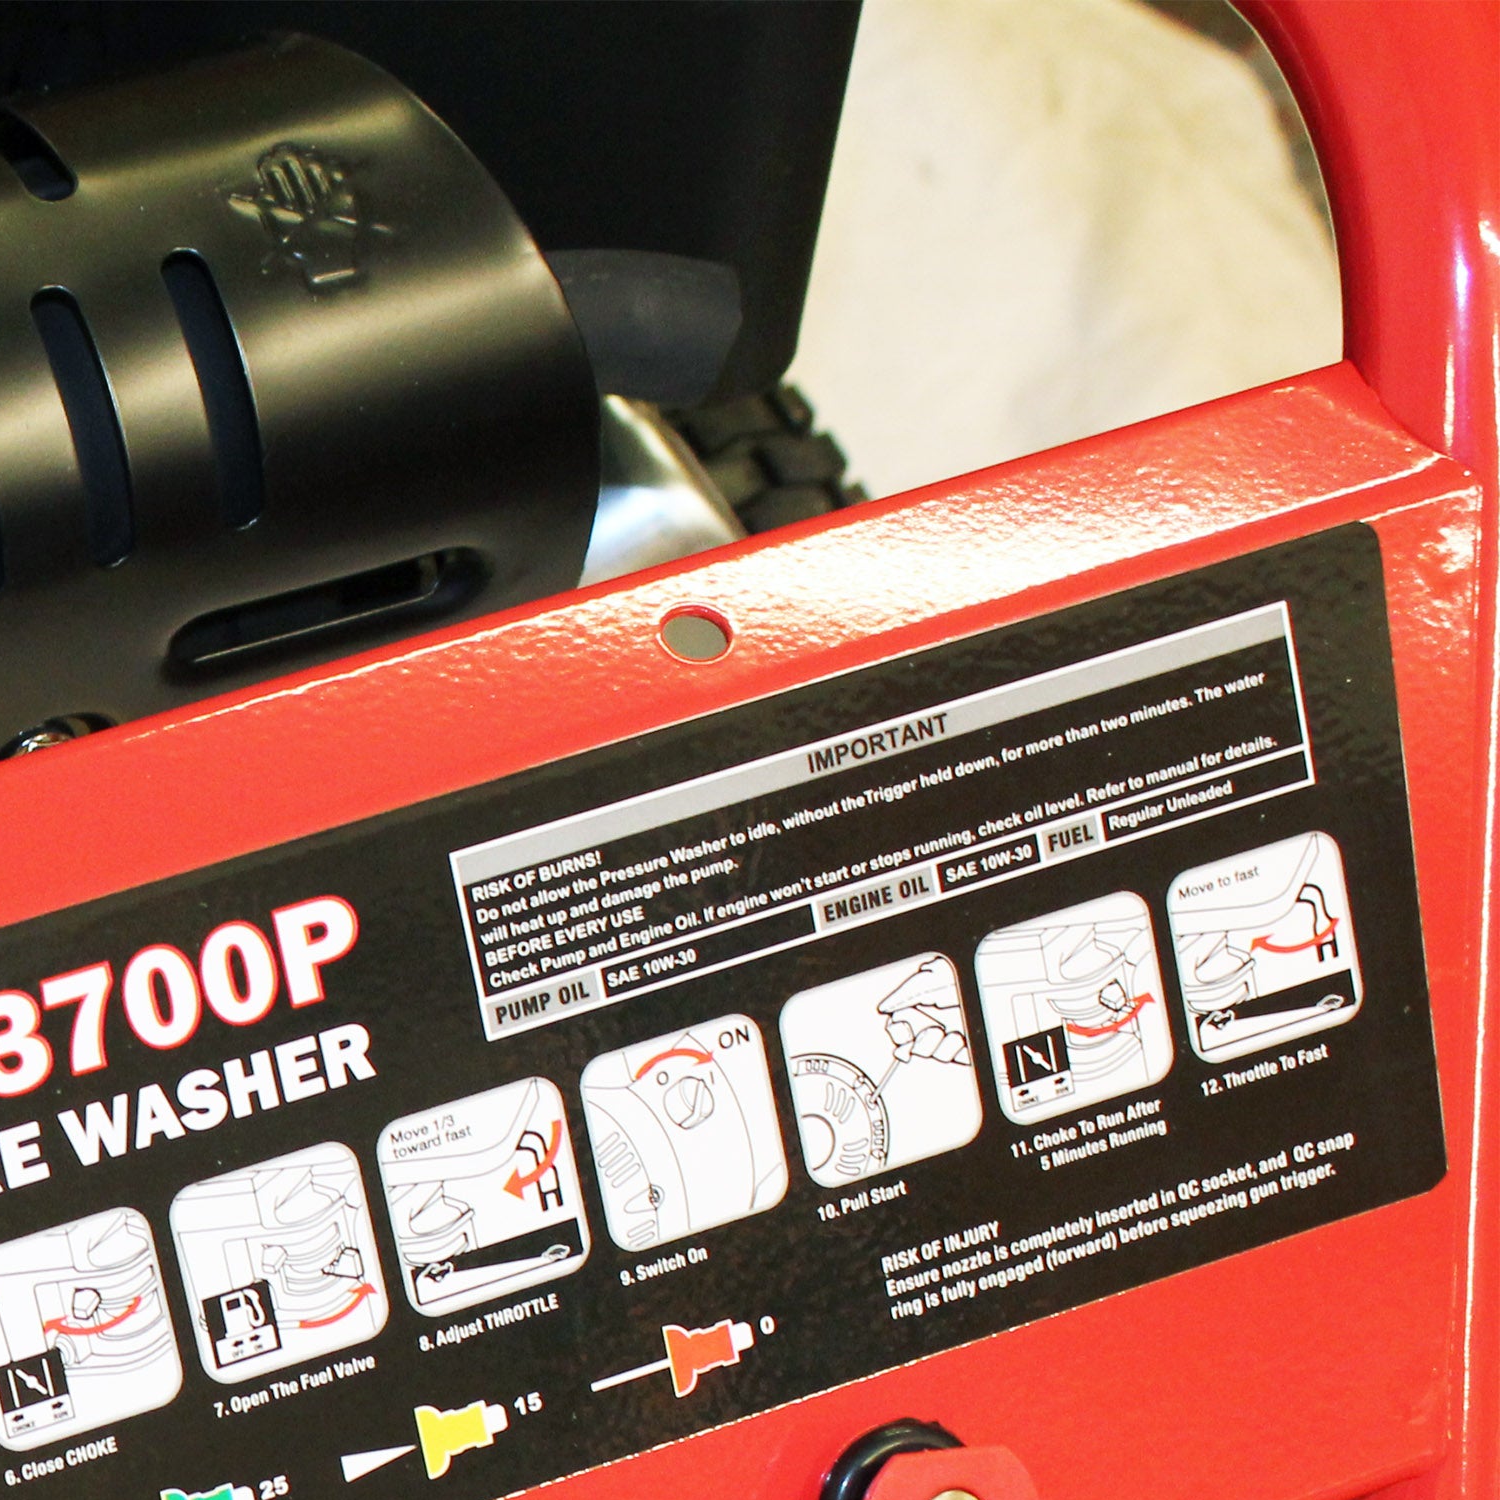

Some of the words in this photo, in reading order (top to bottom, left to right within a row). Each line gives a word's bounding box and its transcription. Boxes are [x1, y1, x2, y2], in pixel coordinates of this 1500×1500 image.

[806, 711, 948, 774] IMPORTANT
[475, 907, 499, 924] Do
[500, 896, 528, 917] not
[529, 884, 571, 908] allow
[571, 877, 598, 895] the
[598, 855, 669, 887] Pressure
[668, 836, 728, 865] Washer
[728, 832, 746, 847] to
[746, 821, 782, 841] idle,
[781, 801, 840, 830] without
[918, 765, 953, 788] held
[954, 755, 1000, 778] down,
[1000, 746, 1023, 763] for
[1024, 734, 1063, 756] more
[1064, 723, 1099, 744] than
[1099, 714, 1128, 733] two
[1129, 696, 1193, 724] minutes.
[1193, 685, 1223, 703] The
[1223, 672, 1265, 695] water
[1107, 803, 1163, 831] Regular
[1165, 779, 1233, 813] Unleaded
[1046, 823, 1094, 853] FUEL
[471, 876, 512, 903] RISK
[512, 869, 536, 889] OF
[537, 849, 602, 882] BURNS!
[945, 860, 978, 883] SAE
[980, 843, 1032, 872] 10W-30
[1177, 881, 1214, 900] Move
[1216, 876, 1231, 888] to
[1233, 866, 1259, 882] fast
[479, 924, 509, 945] will
[509, 913, 545, 937] heat
[546, 909, 568, 926] up
[569, 895, 600, 919] and
[600, 880, 661, 909] damage
[662, 872, 688, 890] the
[689, 858, 739, 885] pump.
[822, 885, 893, 923] ENGINE
[898, 875, 930, 899] OIL
[484, 933, 553, 967] BEFORE
[553, 915, 608, 946] EVERY
[609, 904, 645, 928] USE
[606, 964, 641, 988] SAE
[642, 947, 697, 977] 10W-30
[494, 991, 551, 1025] PUMP
[557, 980, 590, 1005] OIL
[717, 1024, 750, 1049] ON
[1200, 1077, 1224, 1097] 12.
[1222, 1060, 1278, 1089] Throttle
[1278, 1054, 1296, 1071] To
[1296, 1043, 1328, 1066] Fast
[56, 1023, 376, 1167] WASHER
[816, 1202, 840, 1222] 10.
[839, 1190, 869, 1215] Pull
[869, 1179, 907, 1205] Start
[619, 1269, 636, 1286] 9.
[635, 1252, 687, 1281] Switch
[686, 1247, 708, 1264] On
[880, 1246, 920, 1275] RISK
[920, 1238, 941, 1261] OF
[943, 1219, 999, 1254] INJURY
[418, 1334, 435, 1352] 8.
[435, 1317, 484, 1347] Adjust
[483, 1292, 559, 1330] THROTTLE
[759, 1315, 775, 1335] 0
[212, 1401, 230, 1418] 7.
[229, 1389, 270, 1414] Open
[268, 1380, 299, 1400] The
[299, 1365, 334, 1391] Fuel
[332, 1355, 375, 1379] Valve
[513, 1391, 543, 1416] 15
[4, 1468, 21, 1486] 6.
[21, 1456, 65, 1481] Close
[65, 1435, 118, 1466] CHOKE
[258, 1474, 289, 1500] 25
